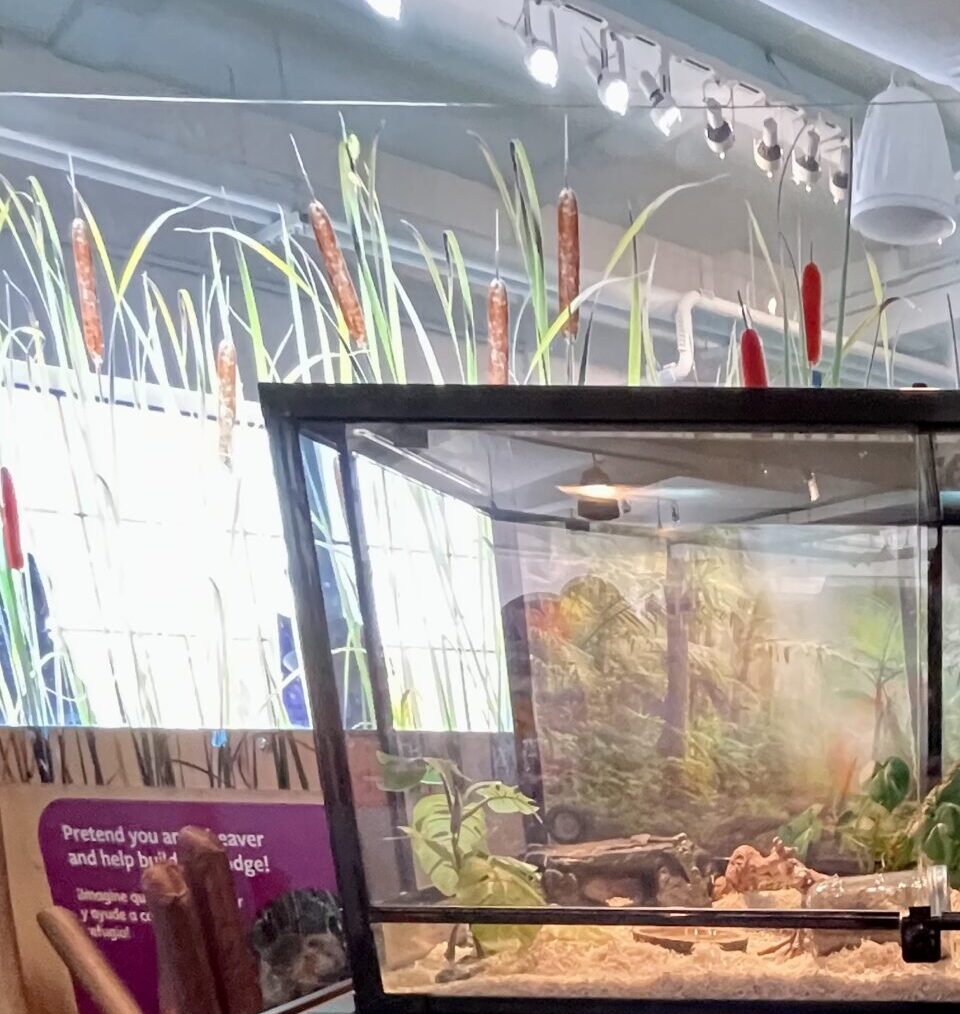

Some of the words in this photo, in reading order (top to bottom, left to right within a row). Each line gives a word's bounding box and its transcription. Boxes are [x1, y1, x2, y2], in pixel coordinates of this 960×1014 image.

[62, 824, 125, 843] Pretend
[128, 831, 159, 848] you
[163, 831, 178, 845] ar
[206, 828, 265, 848] eaver
[68, 849, 97, 866] and
[100, 849, 135, 870] help
[229, 854, 270, 877] dge!
[130, 892, 146, 906] qu
[80, 909, 88, 922] y
[129, 911, 138, 922] a
